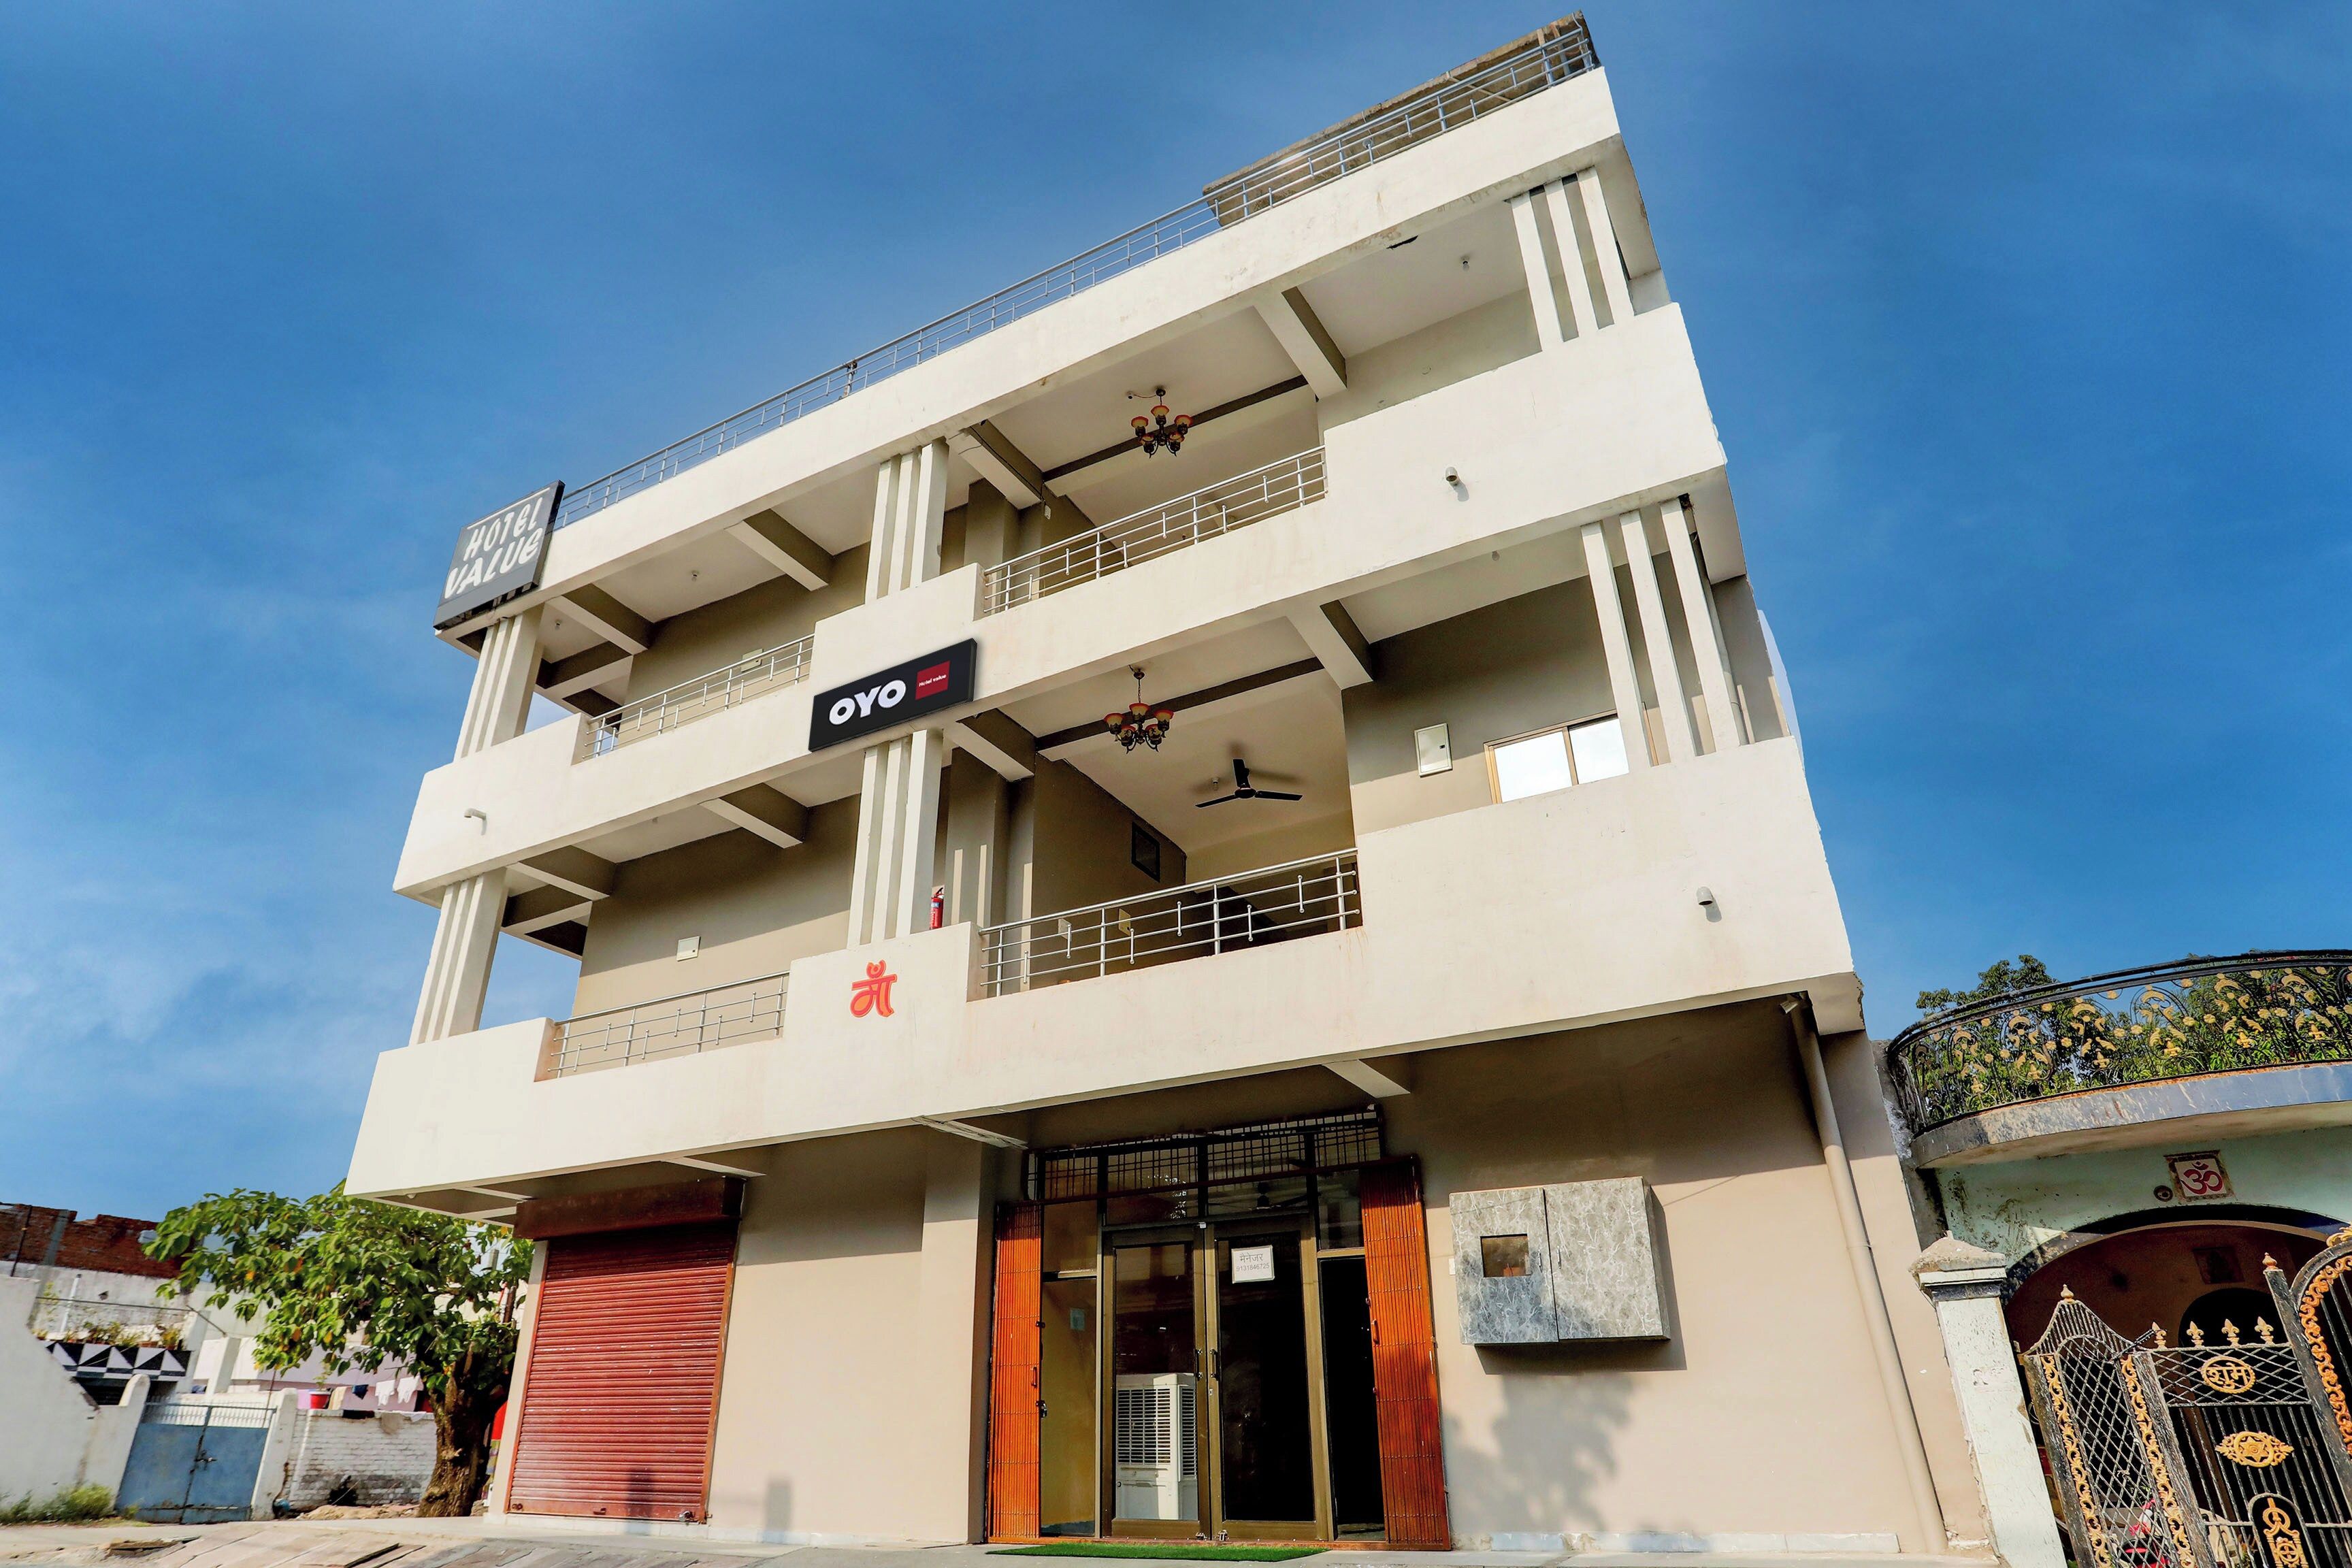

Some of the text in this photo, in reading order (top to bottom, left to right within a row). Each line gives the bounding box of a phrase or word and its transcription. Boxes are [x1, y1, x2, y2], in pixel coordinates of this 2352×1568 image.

[463, 497, 543, 561] HOTEL
[444, 527, 543, 599] VALUE
[829, 679, 906, 725] OYO
[850, 959, 898, 1017] माँ
[1239, 1252, 1263, 1263] मैनेजर
